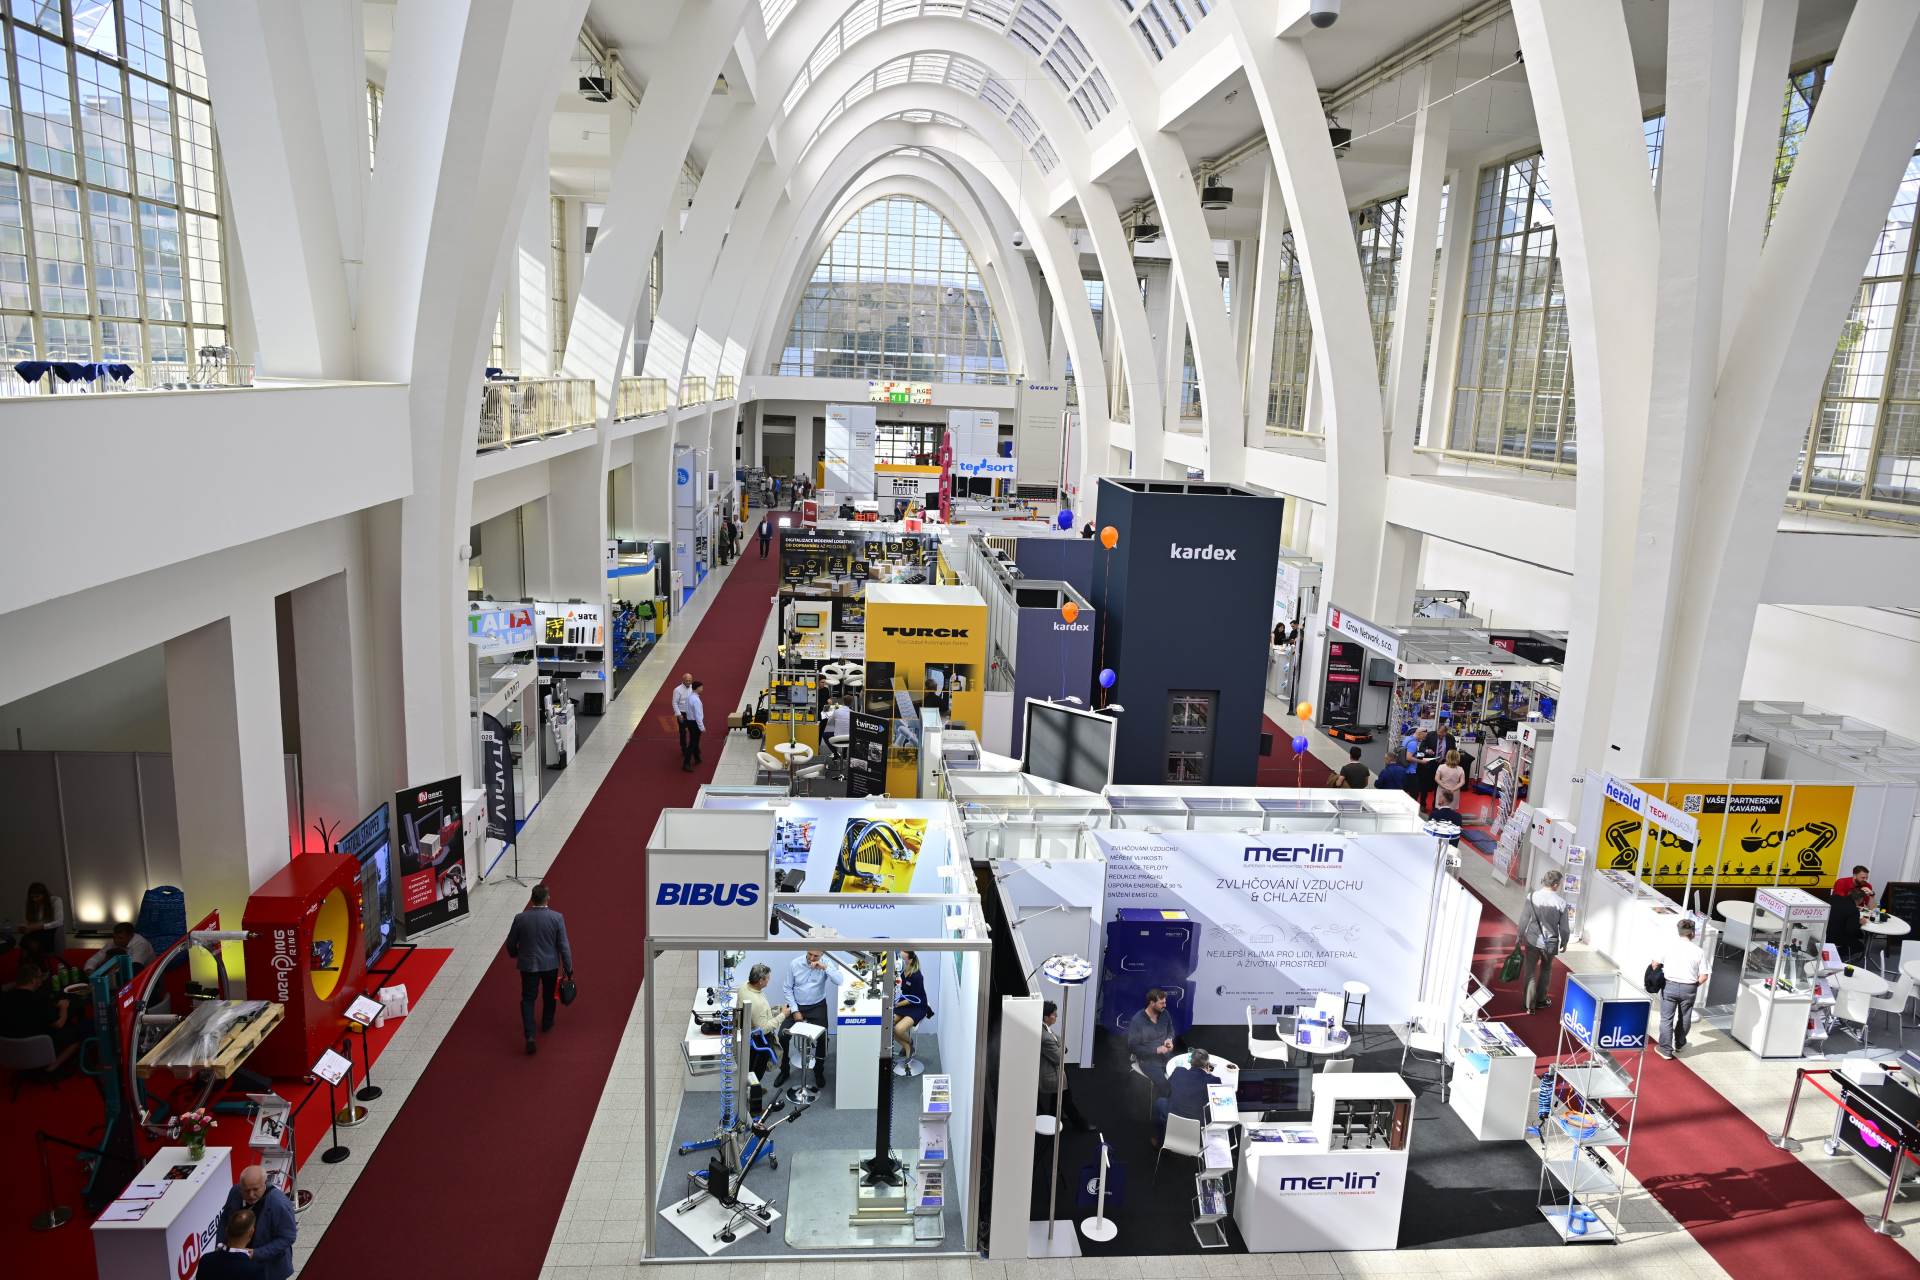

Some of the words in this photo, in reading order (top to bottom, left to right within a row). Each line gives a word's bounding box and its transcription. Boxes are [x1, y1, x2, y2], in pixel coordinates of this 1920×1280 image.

[1170, 543, 1237, 561] kardex
[883, 627, 969, 638] TURCK
[1053, 621, 1089, 631] kardex
[856, 718, 879, 732] twinzo
[1606, 783, 1641, 812] herald
[1706, 795, 1726, 804] VAŠE
[1729, 796, 1780, 806] PARTNERSKÁ
[1729, 804, 1767, 813] KAVÁRNA
[1243, 843, 1345, 863] merlin
[1216, 877, 1300, 891] ZVLHČOVÁNÍ
[1302, 879, 1364, 891] VZDUCHU
[656, 883, 760, 907] BIBUS
[1250, 891, 1260, 902] &
[1262, 890, 1328, 903] CHLAZENÍ
[287, 929, 297, 956] RING
[1206, 949, 1246, 958] NEJLEPŠÍ
[1247, 950, 1275, 958] KLIMA
[1276, 950, 1295, 958] PRO
[1236, 960, 1243, 968] A
[1279, 1171, 1381, 1191] merlin
